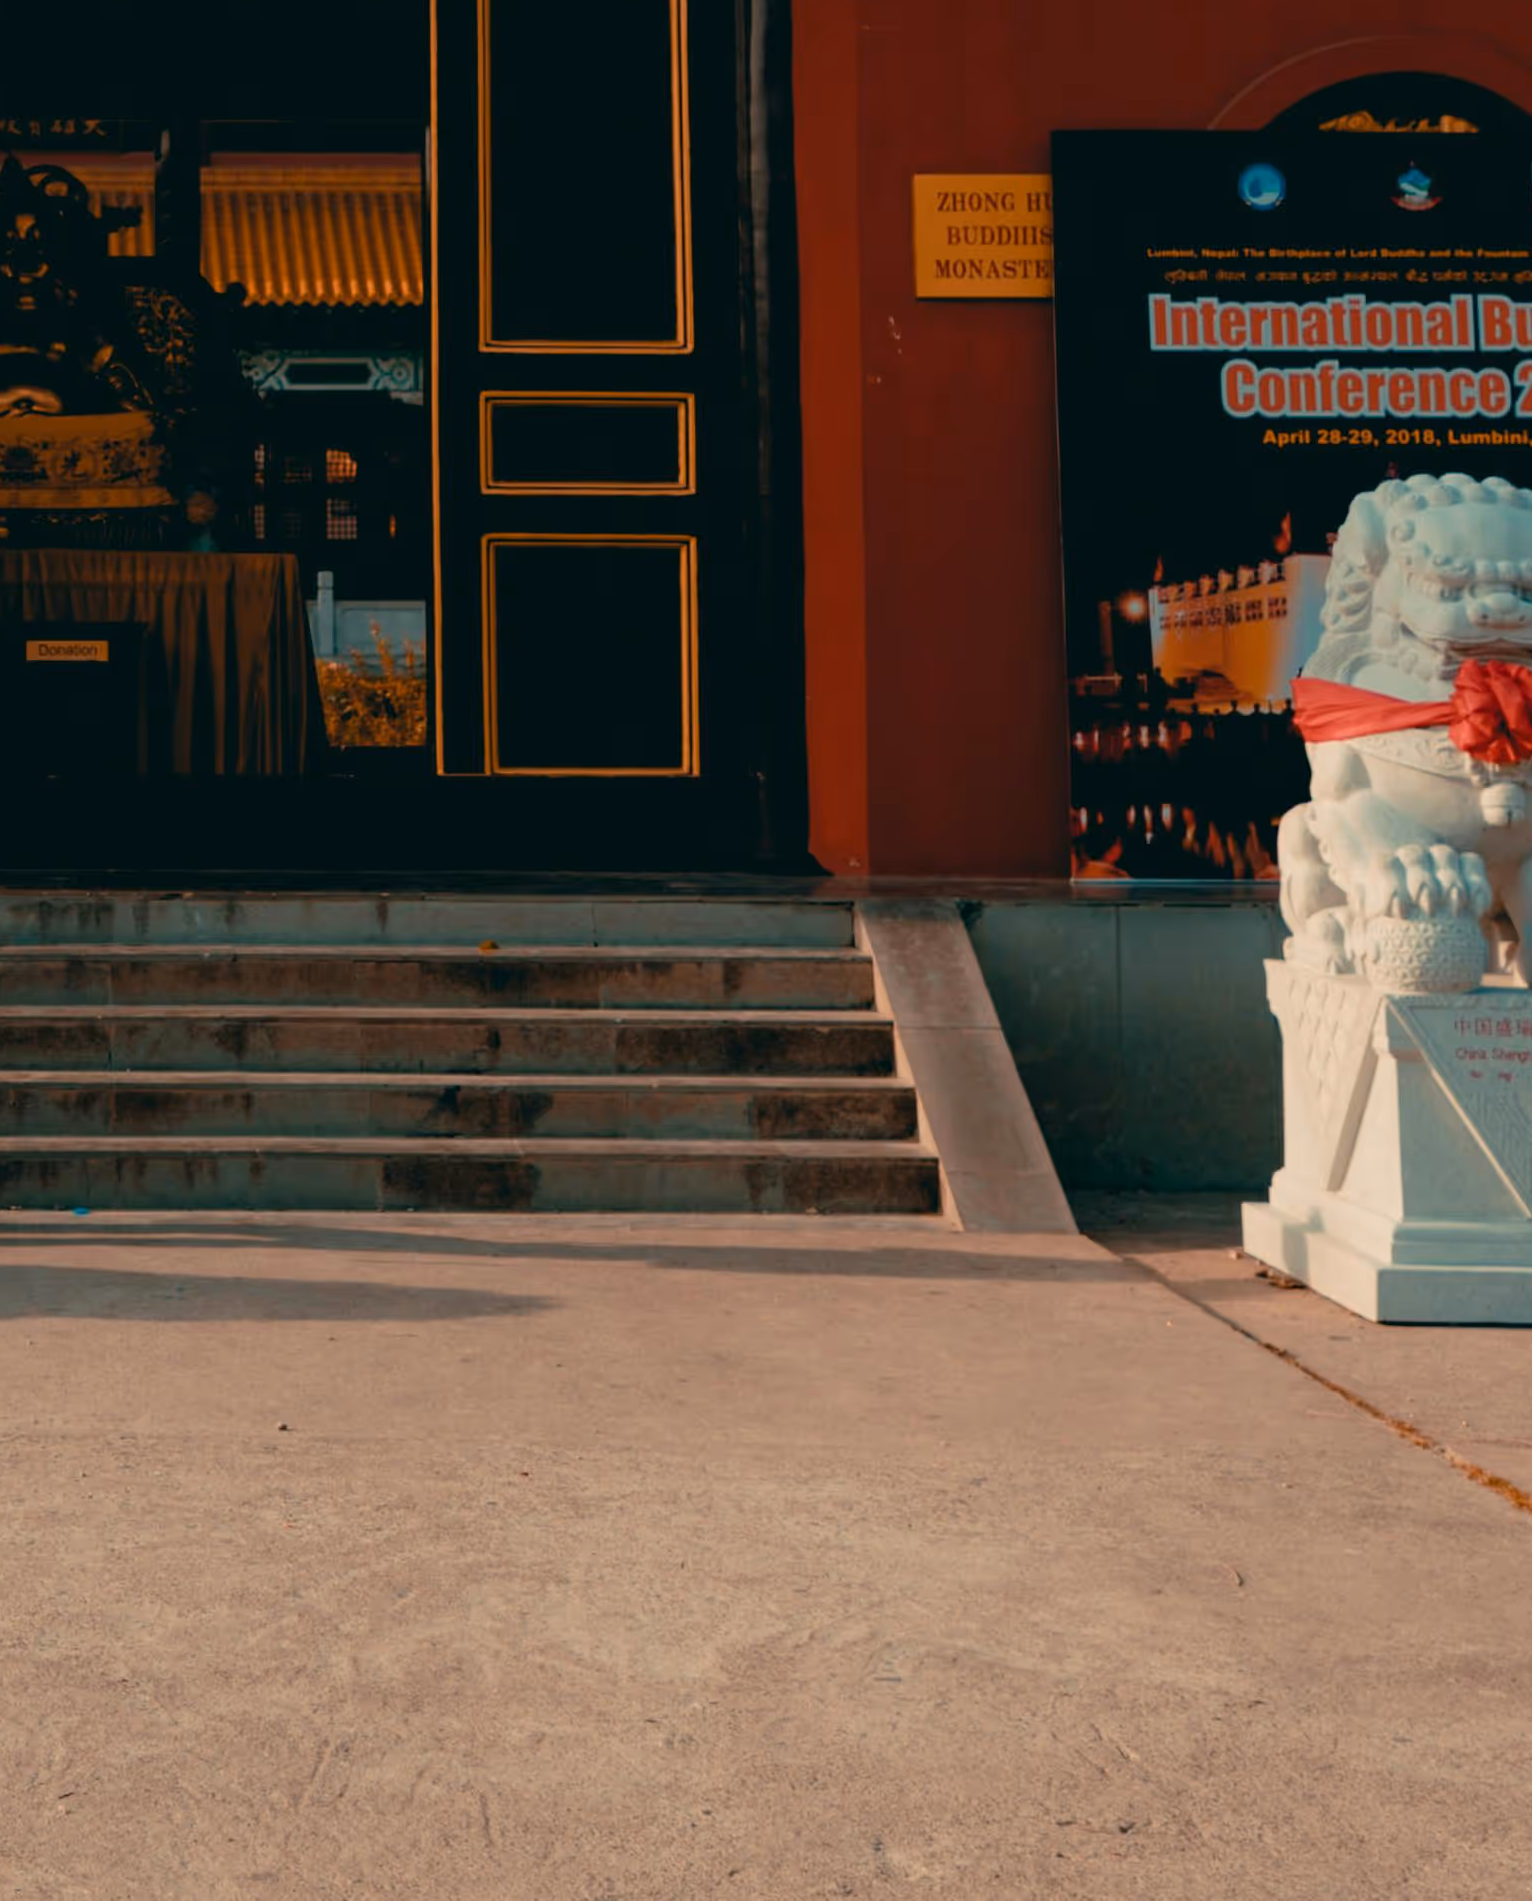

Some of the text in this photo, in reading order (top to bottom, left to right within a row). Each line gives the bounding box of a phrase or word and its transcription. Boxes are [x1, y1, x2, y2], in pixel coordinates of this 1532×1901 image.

[936, 191, 1015, 213] ZHONG
[1147, 248, 1197, 259] Lumbini,
[1243, 248, 1265, 257] The
[1268, 248, 1331, 259] Birthplace
[1333, 248, 1347, 257] of
[1349, 249, 1377, 258] Lord
[1380, 248, 1426, 258] Buddha
[1429, 249, 1451, 258] and
[1454, 249, 1474, 258] the
[1149, 294, 1474, 350] International
[1222, 360, 1511, 418] Conference
[1262, 429, 1311, 447] April
[1317, 429, 1380, 447] 28-29,
[1386, 428, 1442, 447] 2018,
[38, 643, 98, 657] Donation
[1455, 1047, 1487, 1061] China
